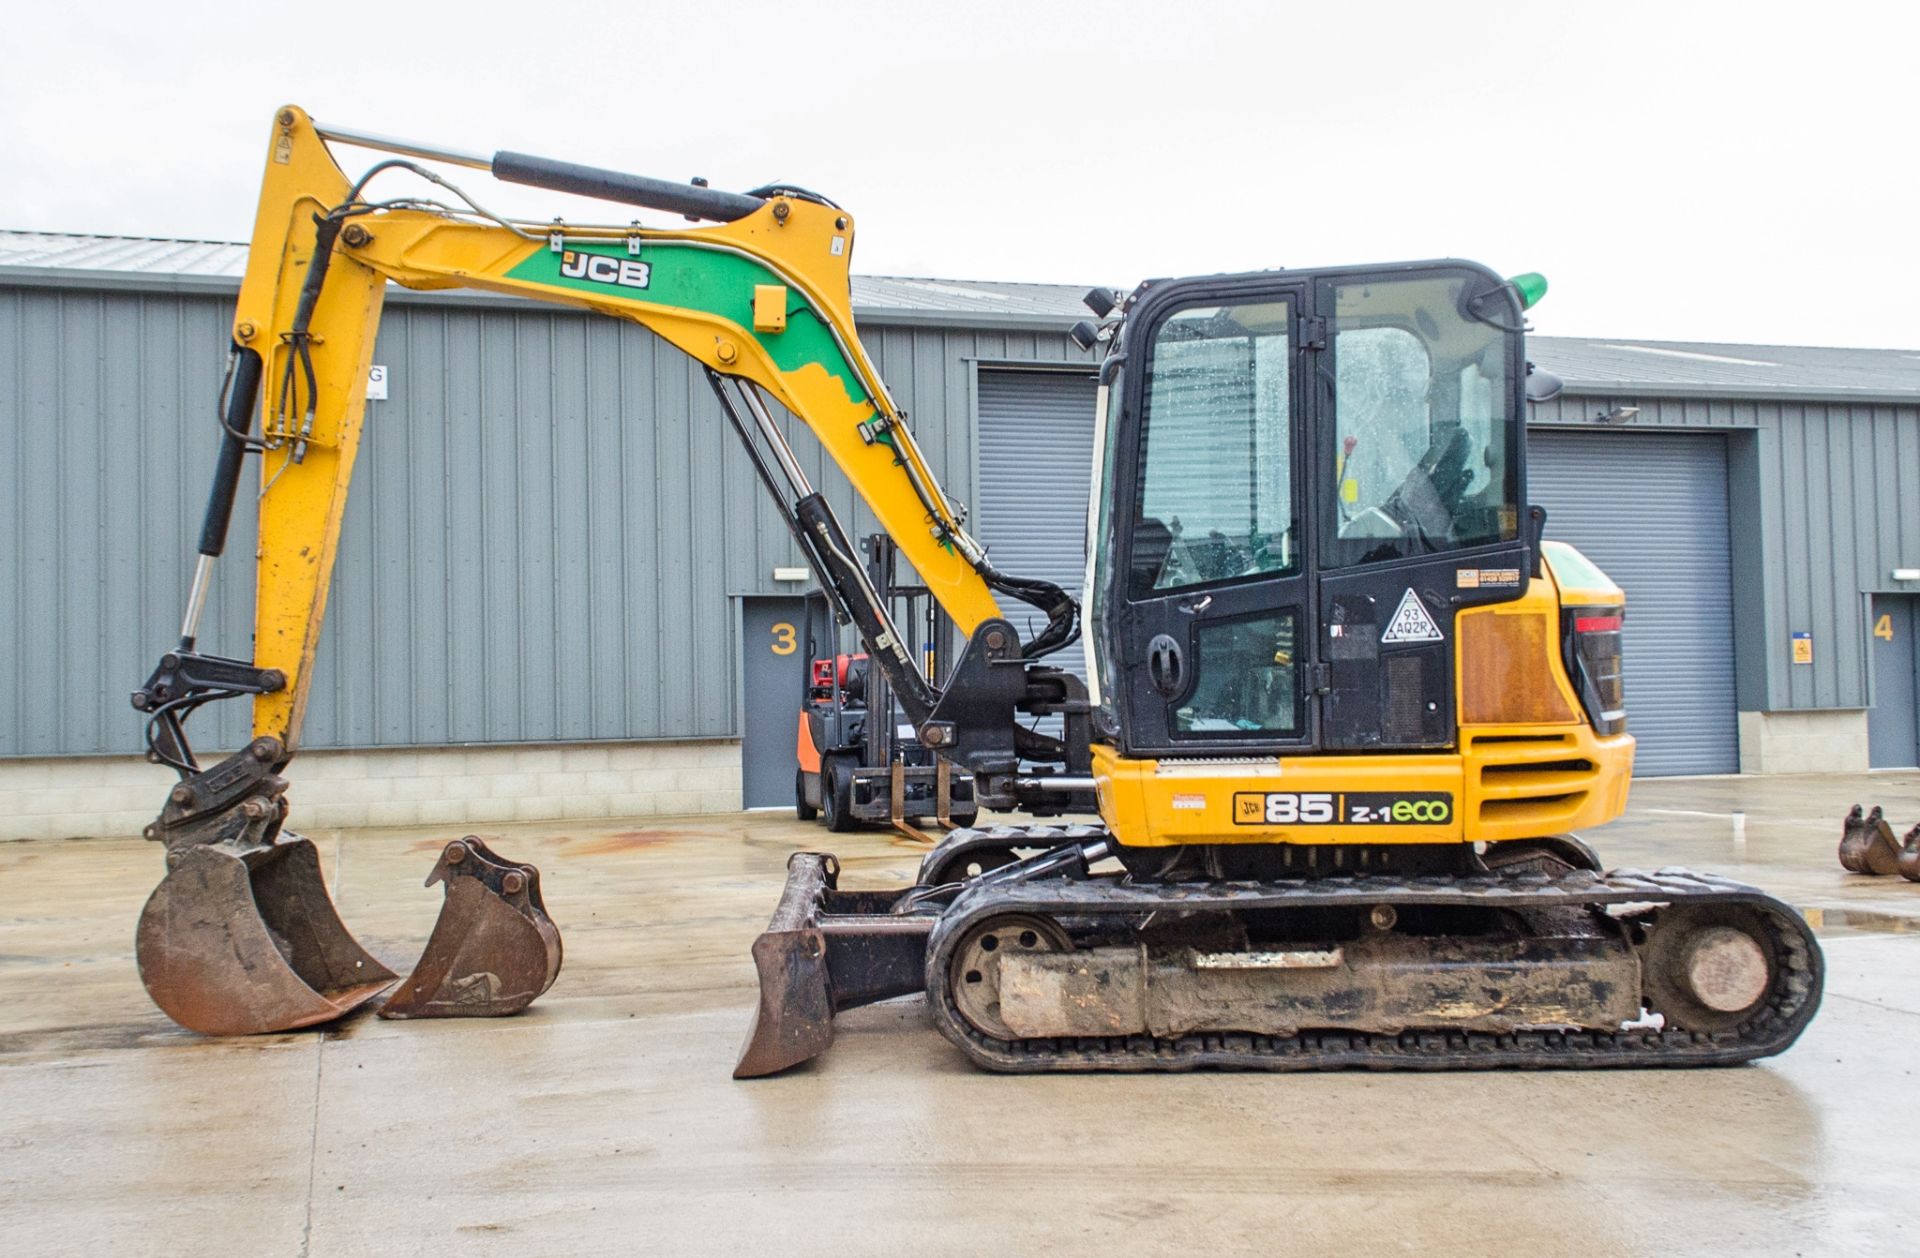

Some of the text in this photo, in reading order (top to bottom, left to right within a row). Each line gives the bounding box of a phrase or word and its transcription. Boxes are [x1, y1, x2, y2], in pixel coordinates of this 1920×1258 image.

[562, 251, 650, 288] JCB
[369, 367, 382, 382] G
[1397, 621, 1429, 634] AQ2R
[1404, 609, 1420, 621] 93
[1874, 614, 1894, 641] 4
[771, 623, 798, 656] 3
[1266, 793, 1333, 823] 85
